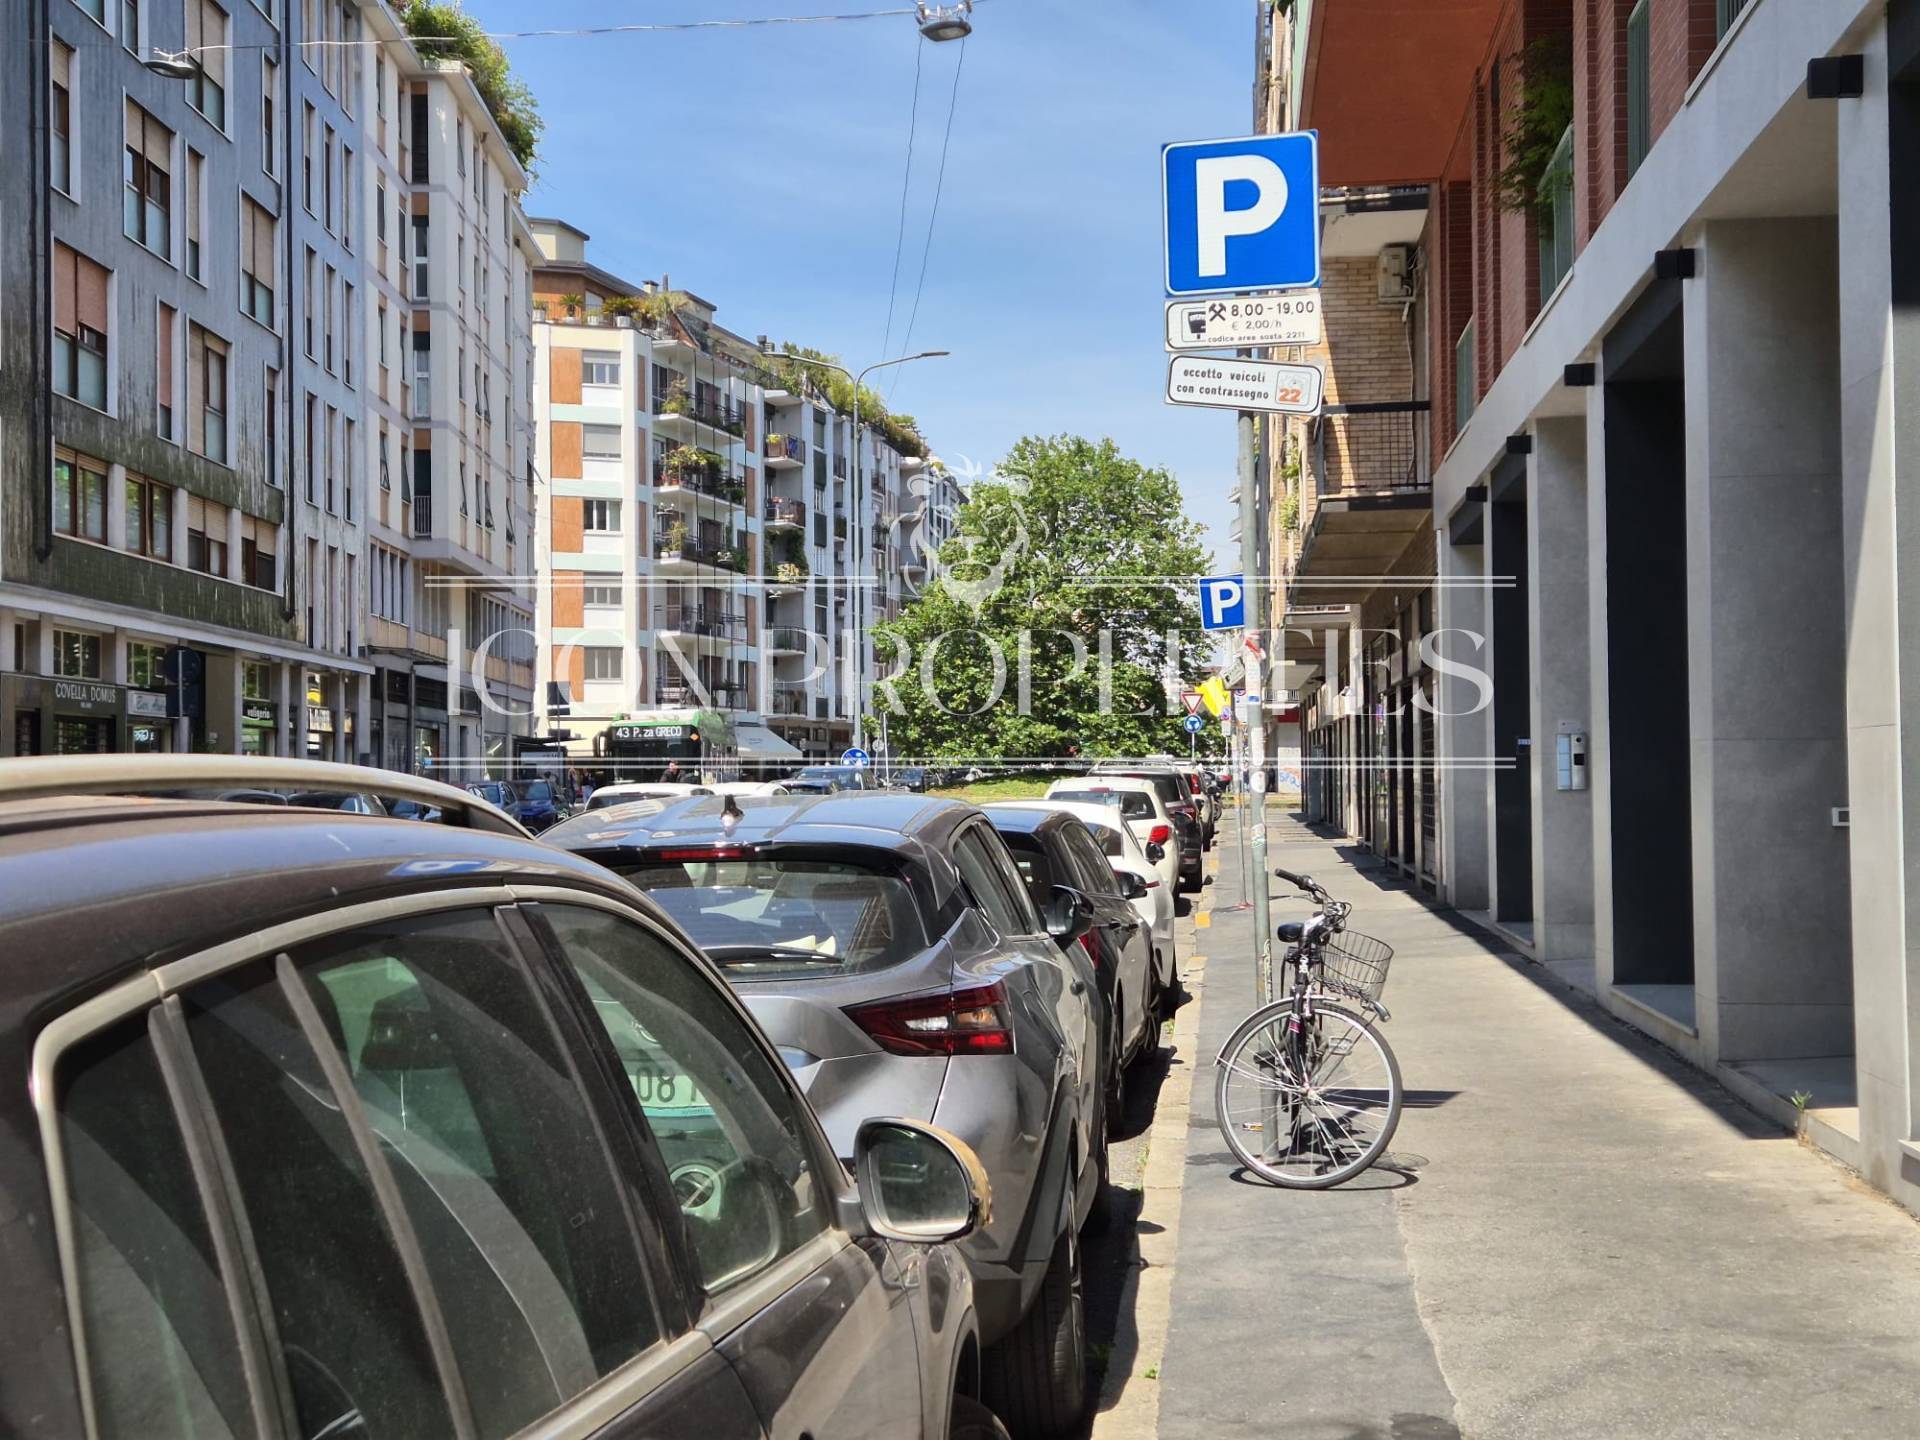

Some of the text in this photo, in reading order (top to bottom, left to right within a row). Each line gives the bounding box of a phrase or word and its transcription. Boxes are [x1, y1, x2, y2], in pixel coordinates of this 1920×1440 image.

[1196, 154, 1289, 278] P
[1208, 334, 1234, 343] codice
[1260, 333, 1282, 341] sosta
[1183, 368, 1266, 383] eccetto veicoli
[1176, 383, 1269, 401] con contrassegno
[1279, 387, 1302, 402] 22
[1210, 581, 1241, 624] P
[55, 682, 116, 703] COVELLA DOMUS
[616, 727, 630, 738] 43
[655, 726, 682, 737] GRECO
